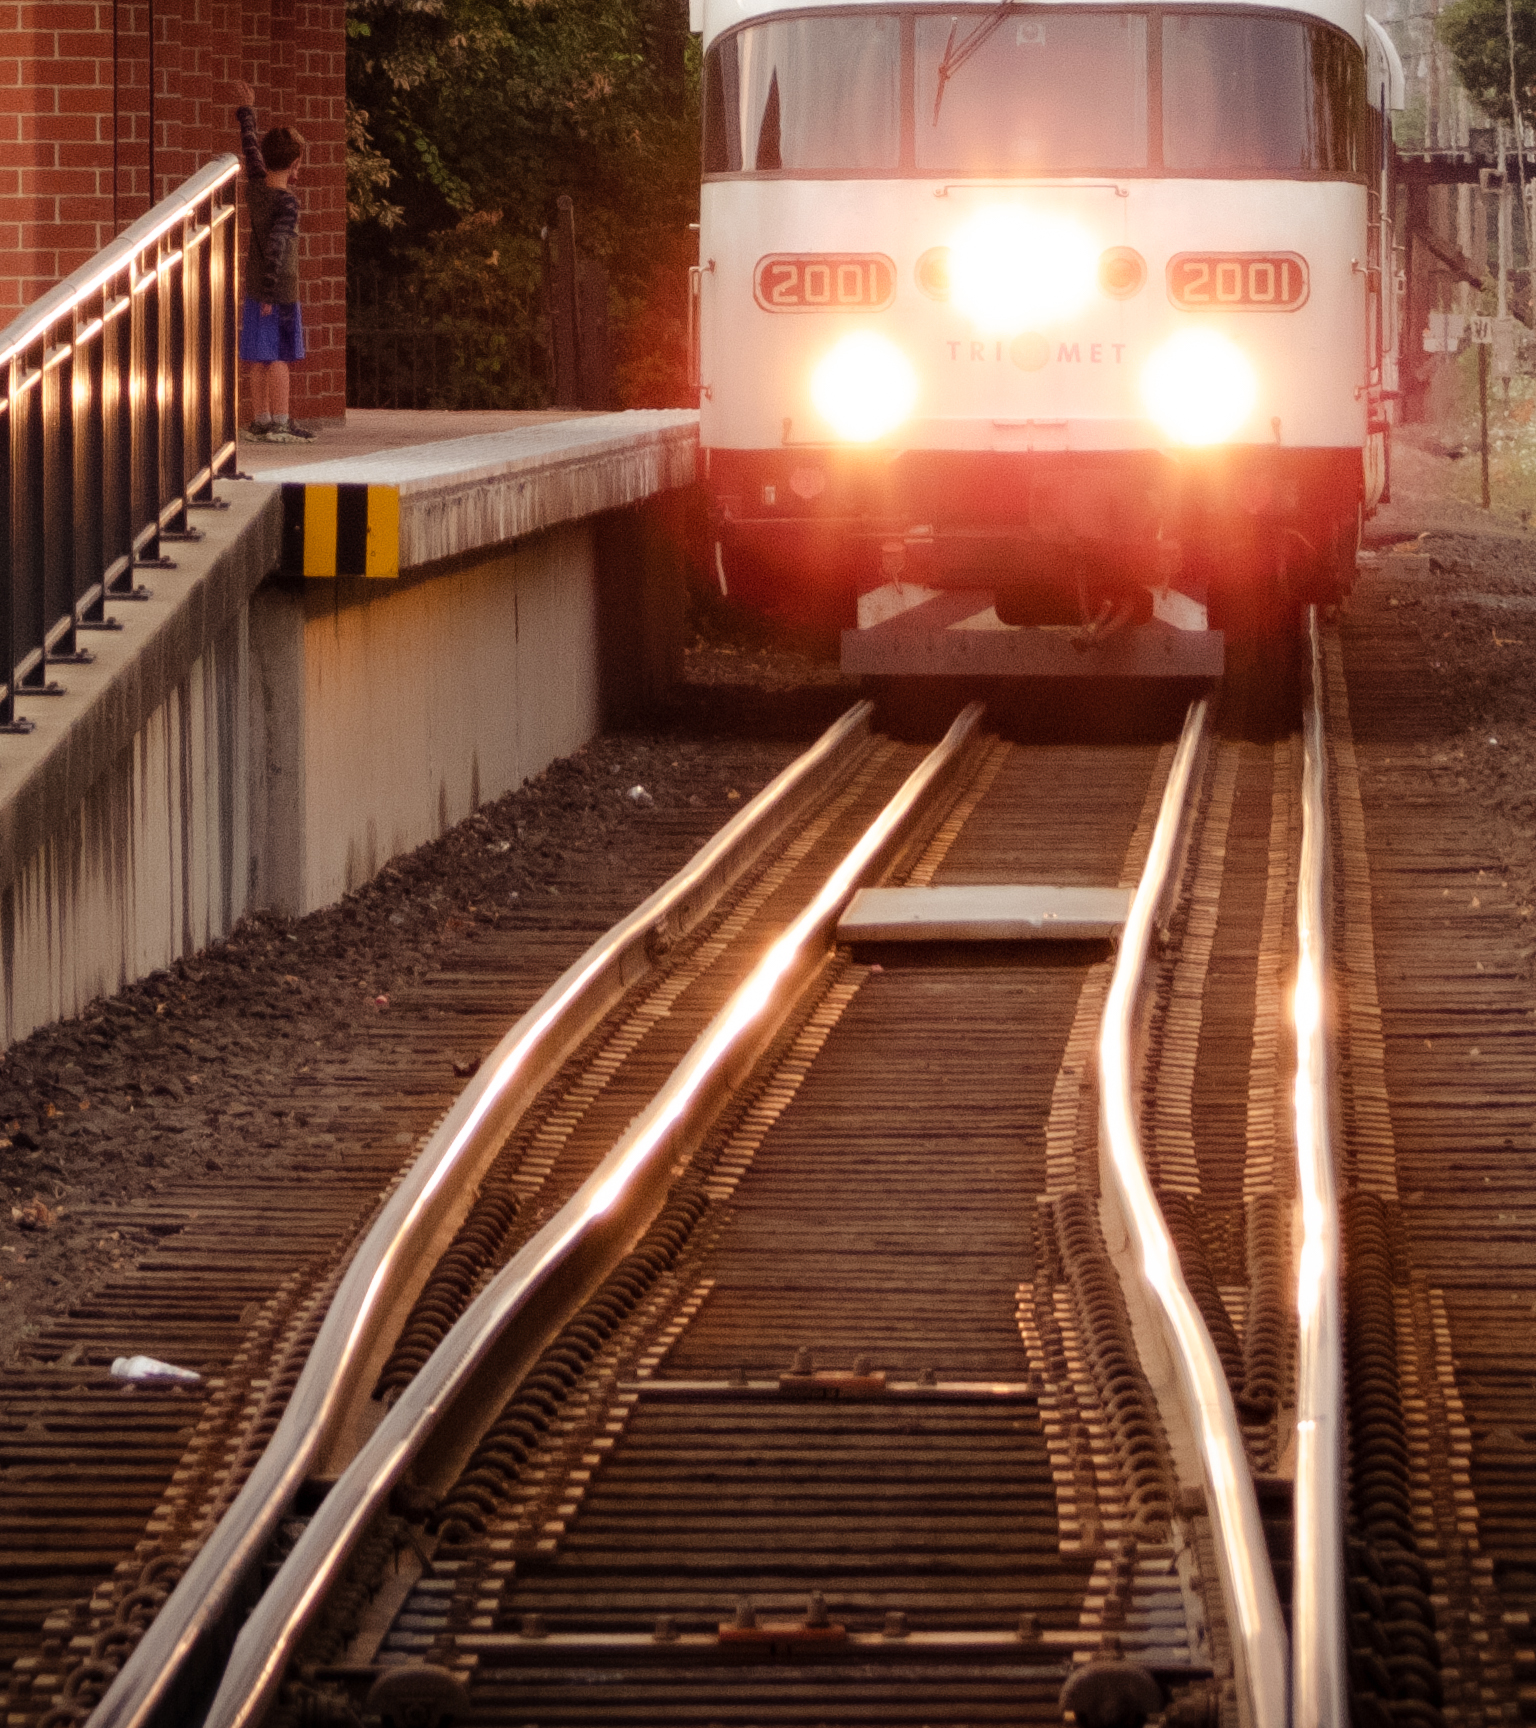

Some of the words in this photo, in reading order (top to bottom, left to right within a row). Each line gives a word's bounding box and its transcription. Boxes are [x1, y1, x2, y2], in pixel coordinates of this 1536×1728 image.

[771, 263, 877, 303] 2001
[1183, 262, 1290, 302] 2001
[946, 340, 1002, 362] TRI
[1056, 342, 1126, 364] MET
